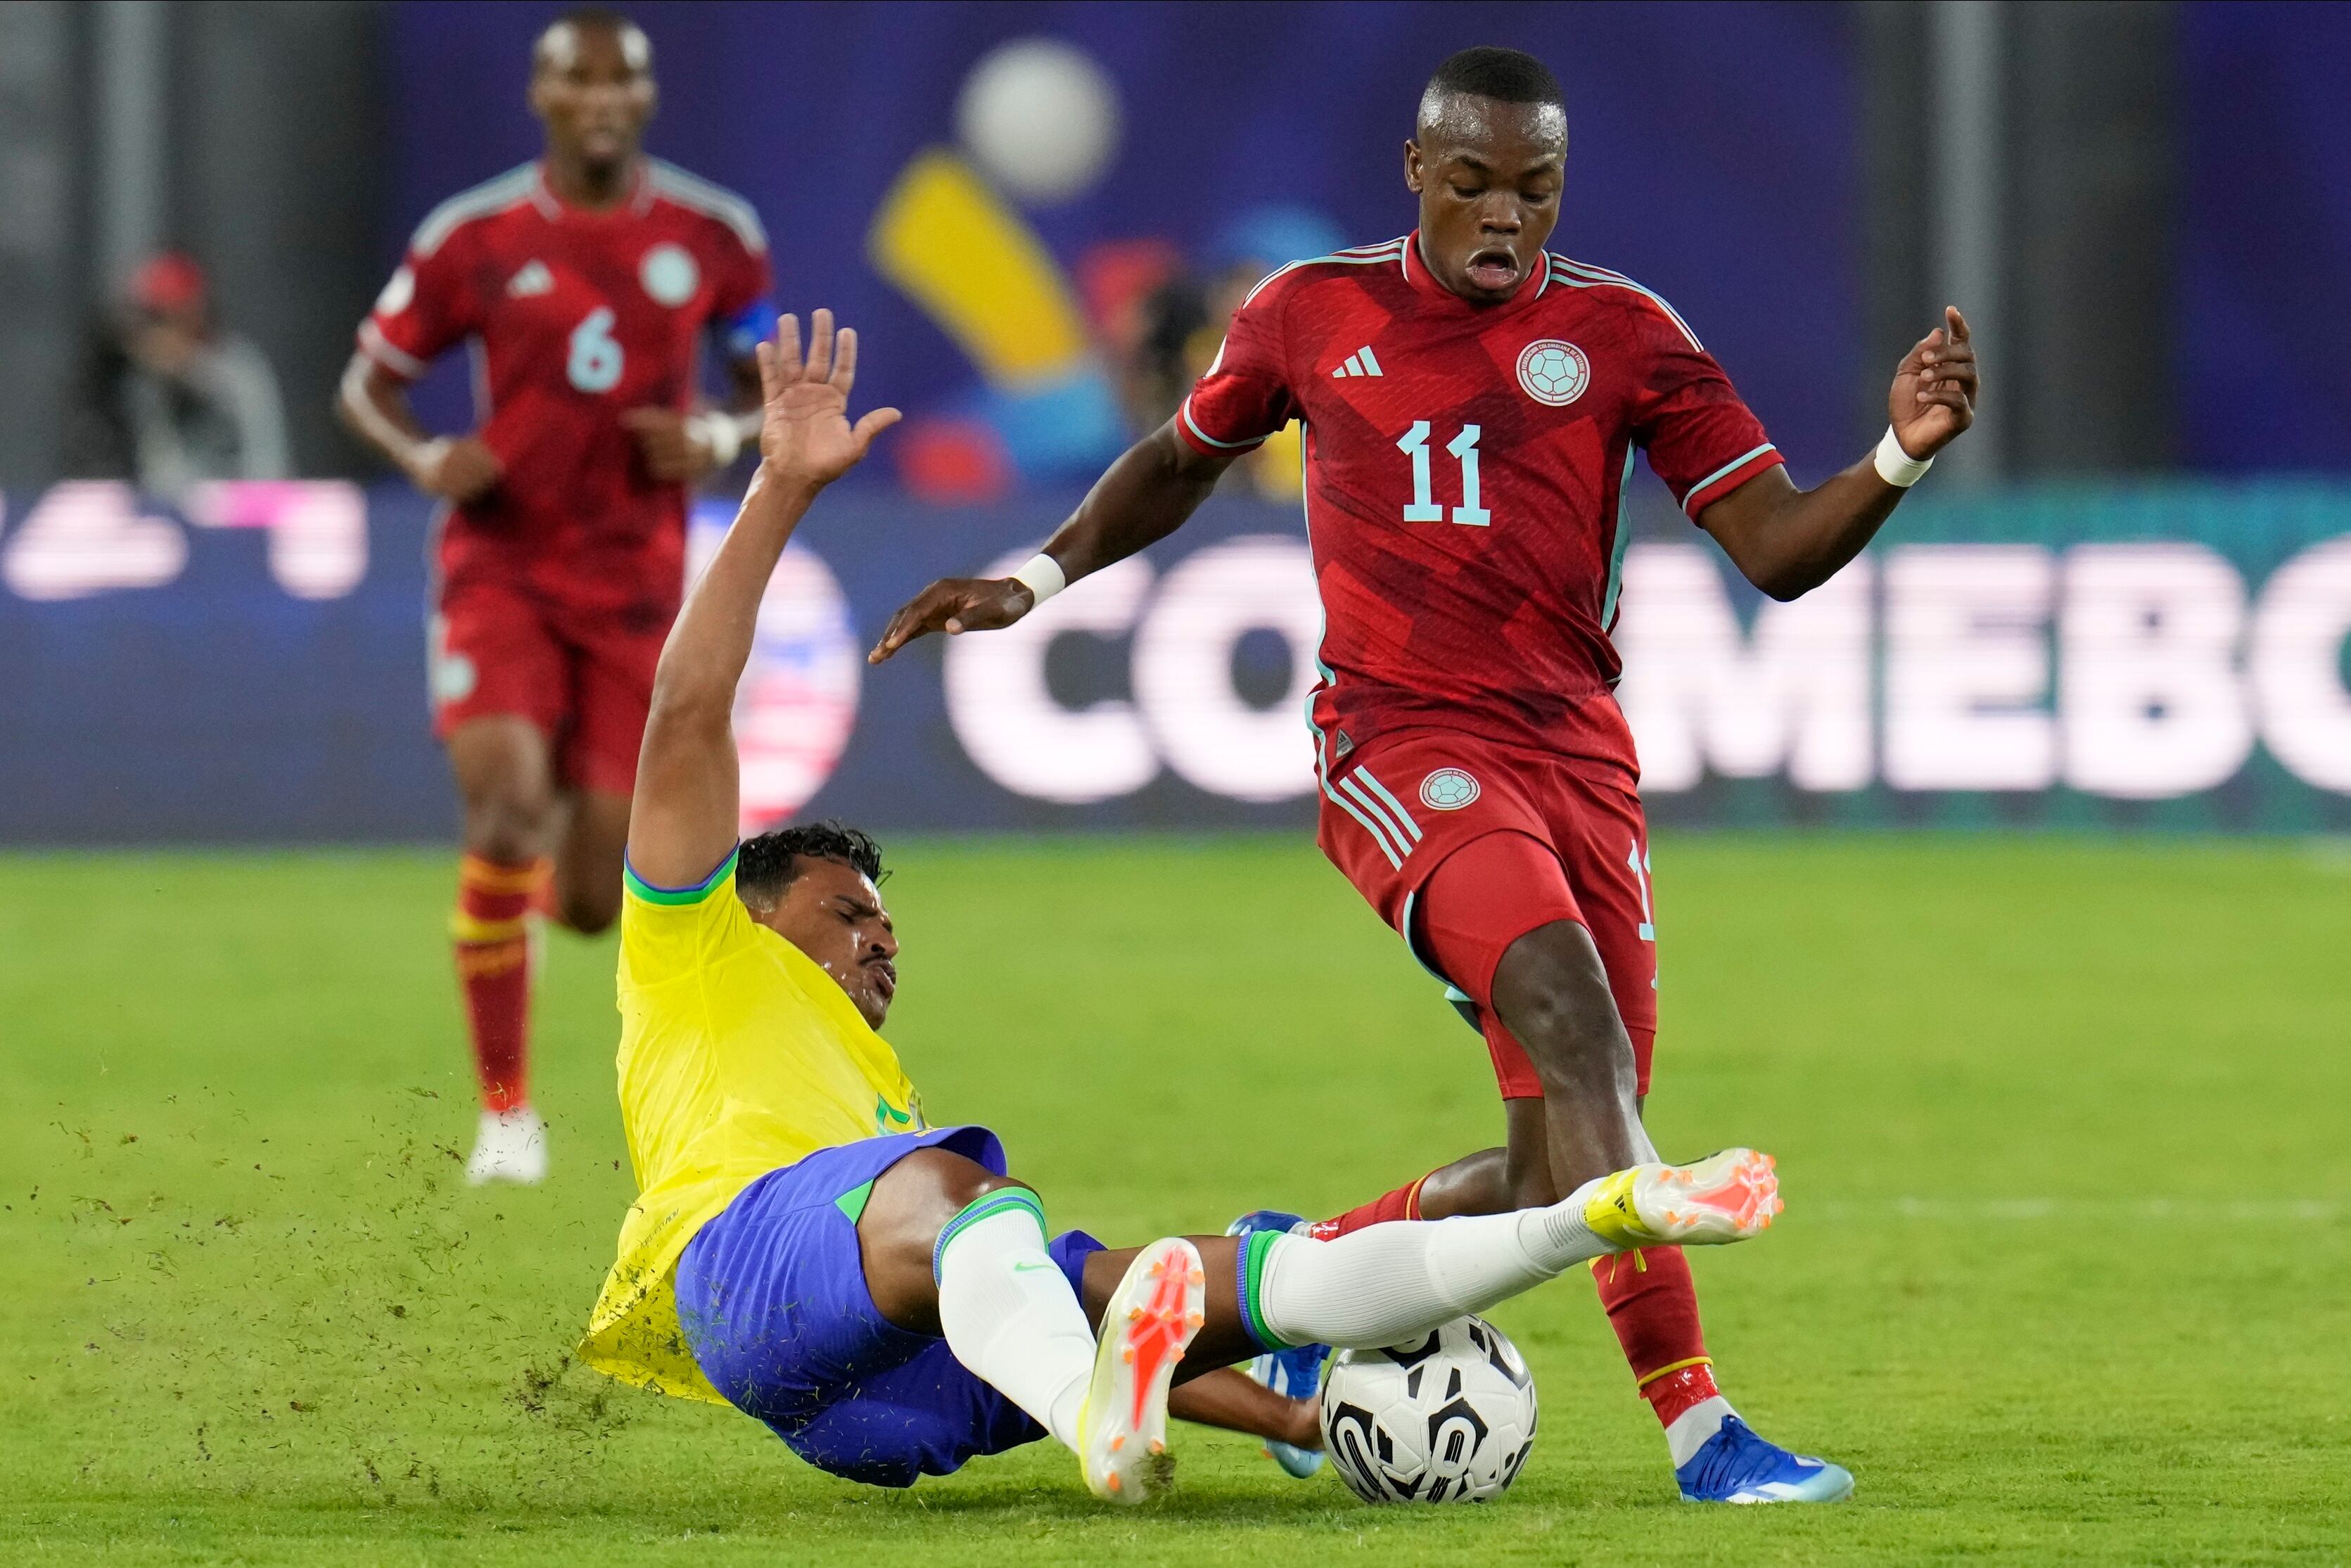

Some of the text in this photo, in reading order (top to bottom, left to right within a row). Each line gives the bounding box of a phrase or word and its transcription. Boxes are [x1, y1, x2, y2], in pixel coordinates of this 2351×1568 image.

[566, 306, 625, 393] 6
[1538, 343, 1570, 352] COLOMBIANA
[1396, 421, 1491, 526] 11
